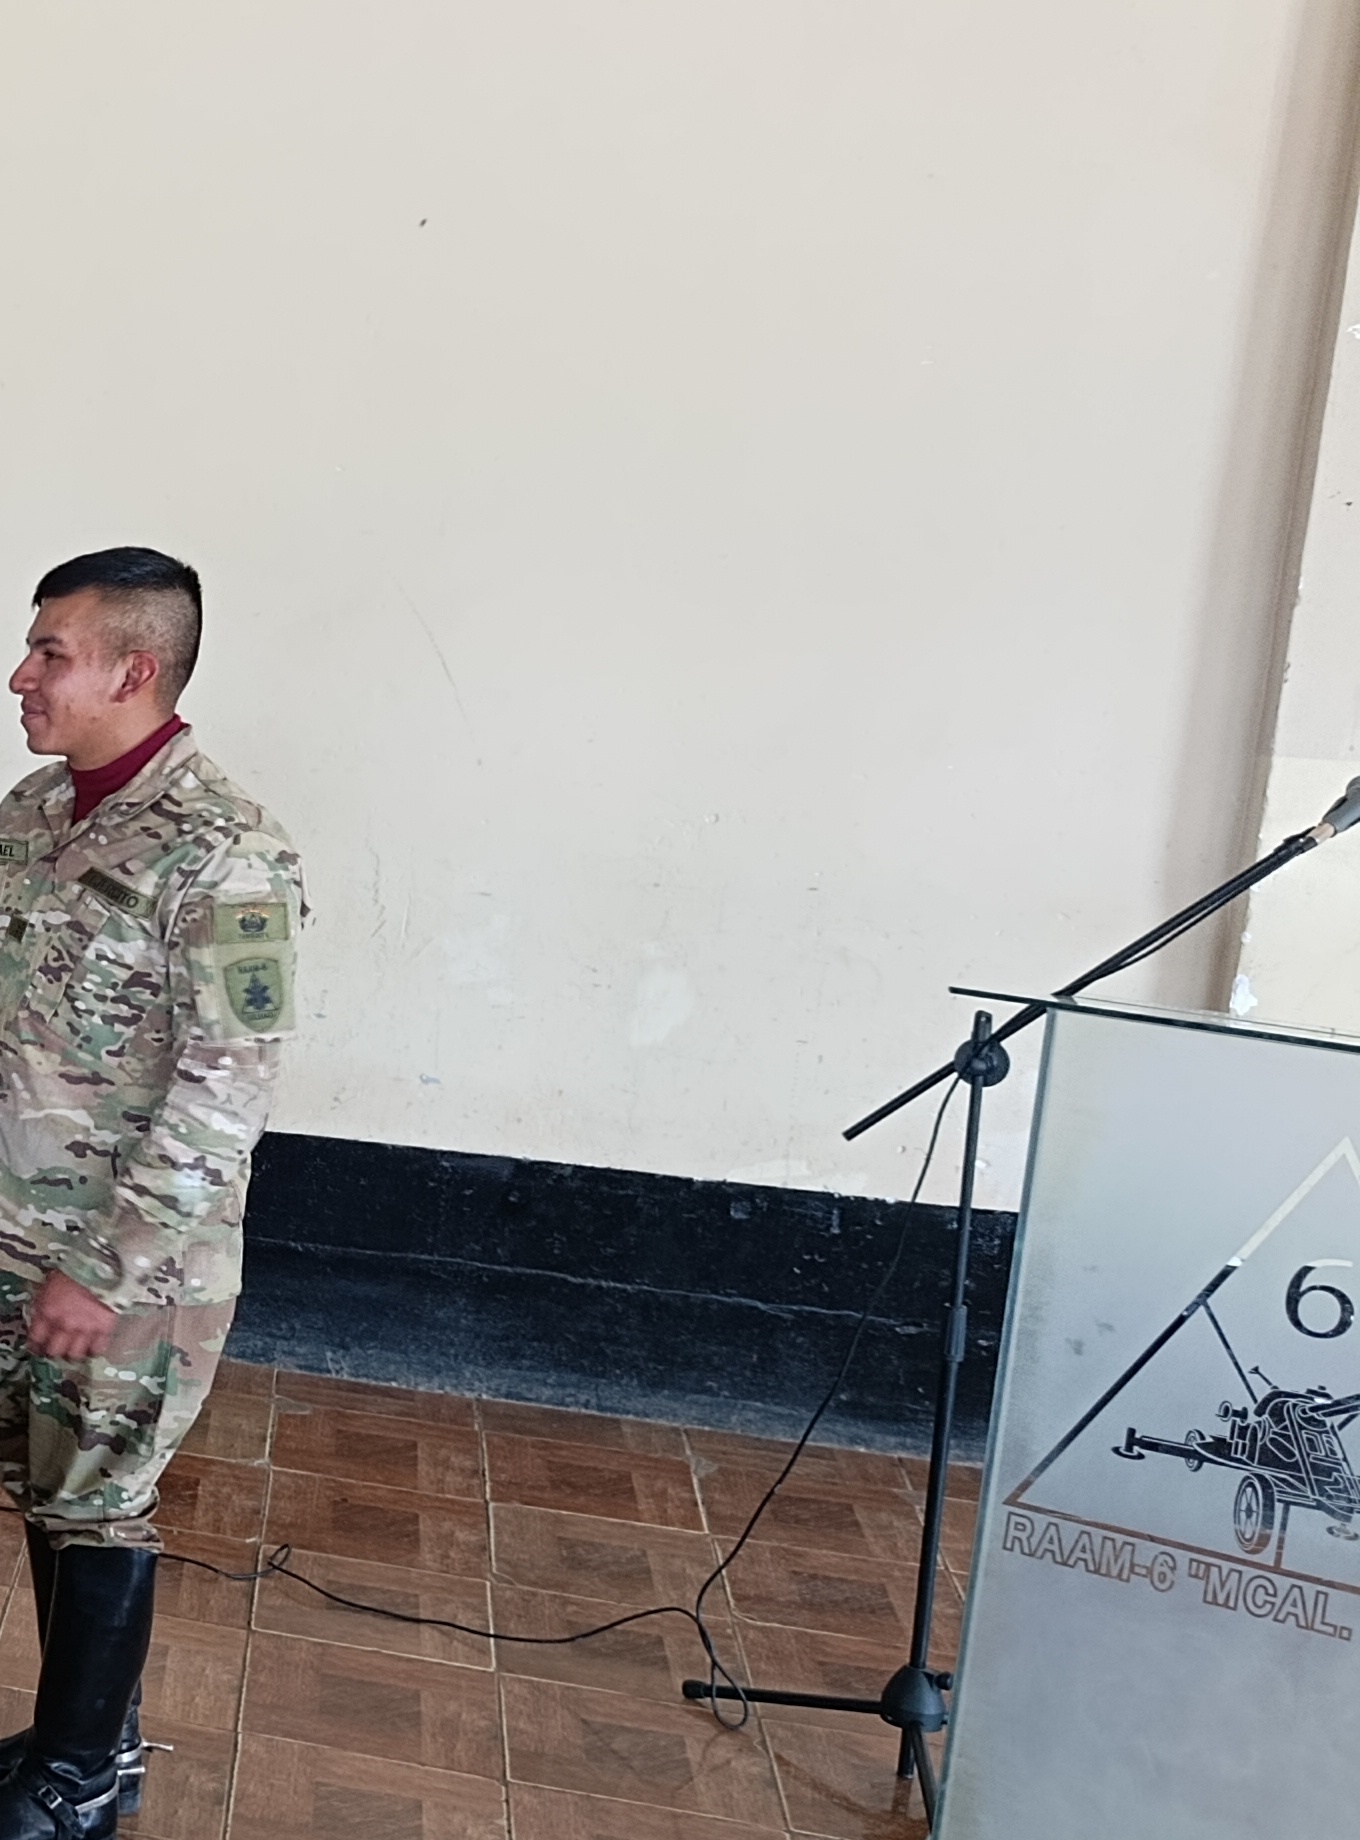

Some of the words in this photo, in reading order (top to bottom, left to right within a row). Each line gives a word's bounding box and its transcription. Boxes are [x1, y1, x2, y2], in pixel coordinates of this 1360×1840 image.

[1285, 1259, 1354, 1338] 6
[1002, 1511, 1177, 1592] RAAM-6
[1188, 1558, 1353, 1641] "MCAL.
